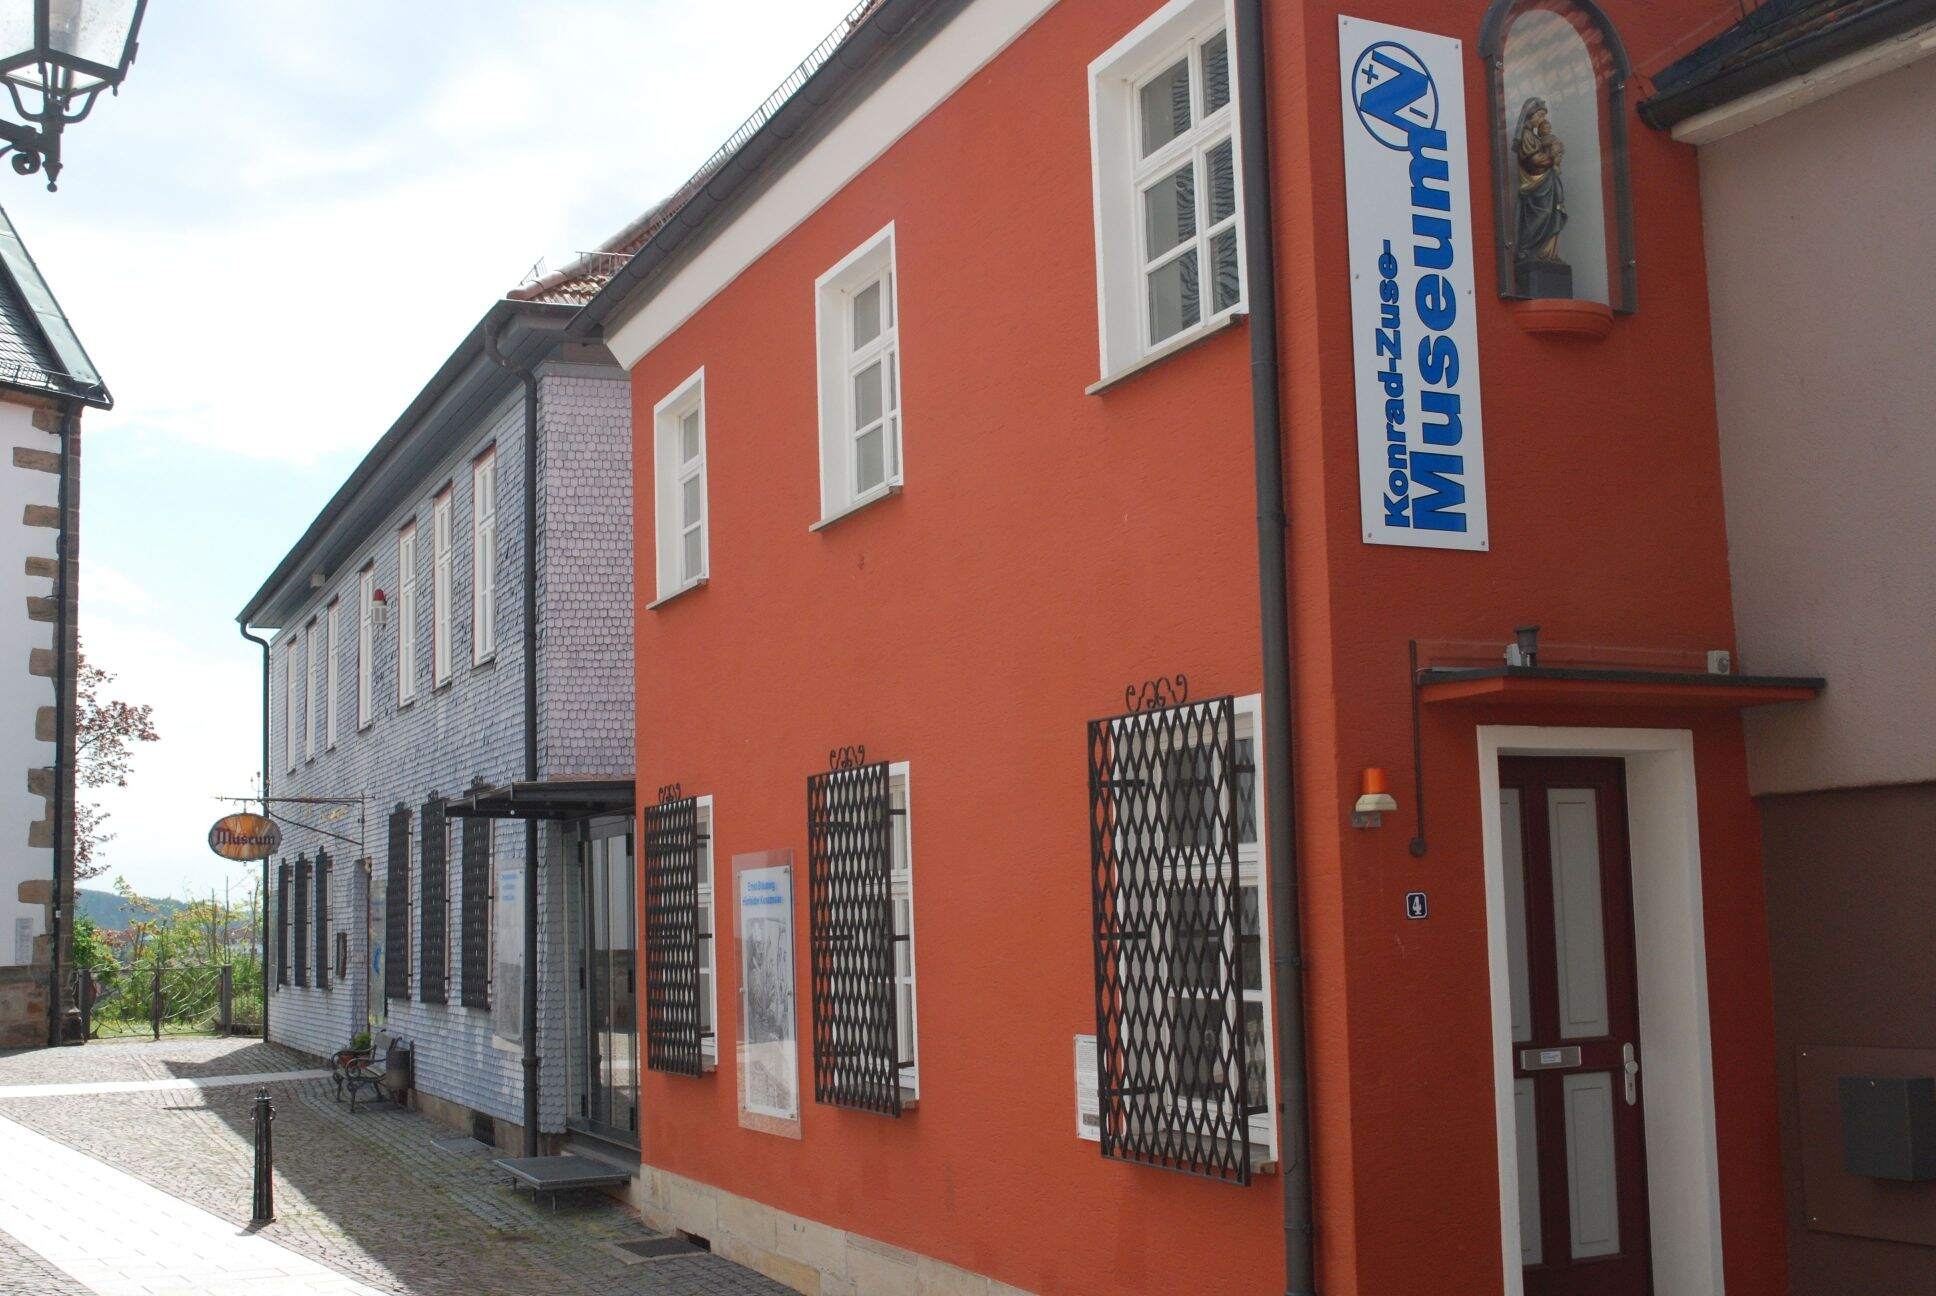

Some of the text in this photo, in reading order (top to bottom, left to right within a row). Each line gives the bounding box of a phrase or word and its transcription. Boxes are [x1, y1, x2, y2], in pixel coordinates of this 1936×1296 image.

[1375, 239, 1411, 528] Konrad-Zuse-
[1408, 128, 1468, 533] Museum
[213, 827, 276, 846] Museum
[1412, 895, 1422, 915] 4
